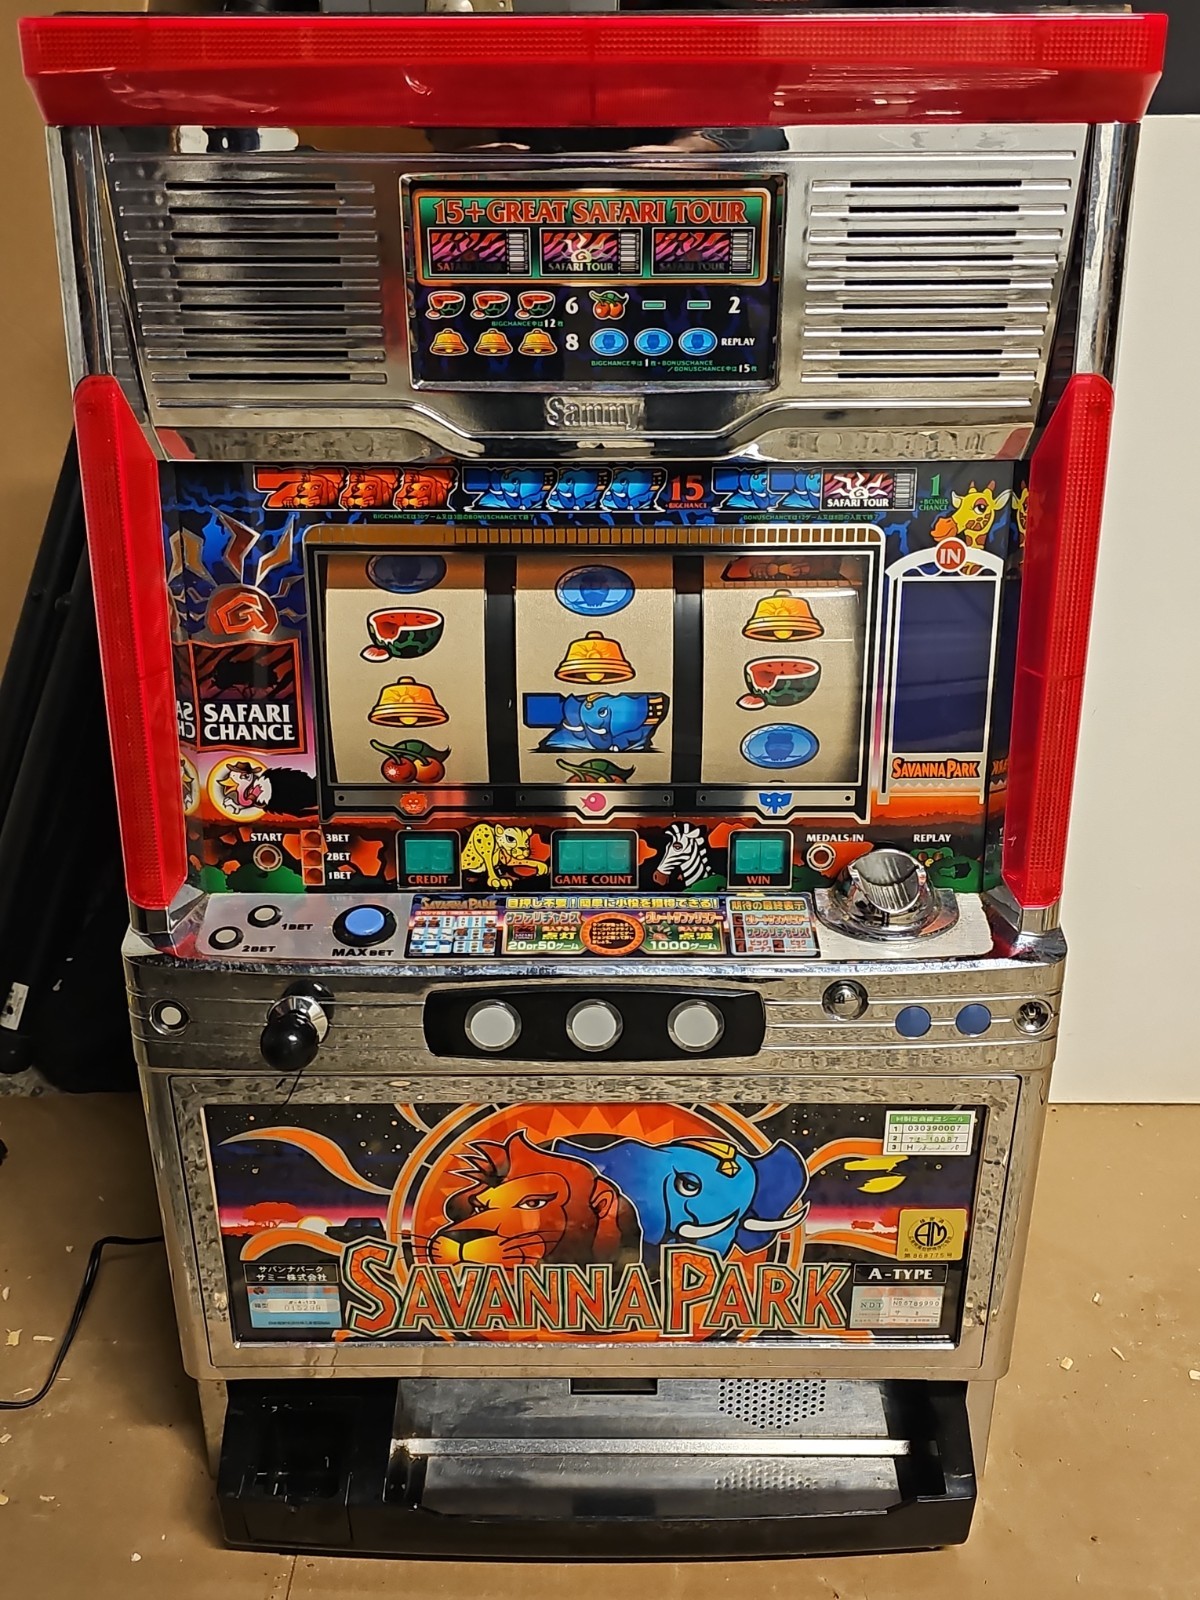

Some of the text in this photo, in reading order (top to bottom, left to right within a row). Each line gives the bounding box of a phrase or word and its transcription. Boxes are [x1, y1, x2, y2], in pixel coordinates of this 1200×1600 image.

[573, 200, 666, 224] SAFARI
[672, 200, 749, 224] TOUR
[548, 262, 614, 272] SAFARI TOUR
[565, 296, 579, 315] 6
[728, 296, 741, 314] 2
[565, 333, 579, 351] 8
[721, 337, 756, 346] REPLAY
[545, 396, 641, 431] Sammy
[670, 473, 705, 500] 15
[929, 474, 941, 497] 1
[827, 499, 890, 508] SAFARI TOUR
[939, 548, 962, 565] IN
[203, 703, 290, 723] SAFARI
[204, 724, 296, 741] CHANCE
[250, 833, 283, 842] START
[326, 833, 350, 843] 3BET
[806, 833, 864, 843] MEDALS IN
[913, 833, 952, 843] REPLAY
[326, 852, 351, 862] 2BET
[328, 872, 352, 880] 1BET
[408, 875, 448, 884] CREDIT
[554, 875, 634, 885] GAME COUNT
[746, 875, 771, 885] WIN
[468, 897, 498, 909] PARK
[282, 923, 313, 931] 1BET
[541, 932, 577, 940] 点灯
[242, 945, 276, 953] 2BET
[650, 941, 717, 950] 1000ゲーム
[332, 948, 368, 957] MAX
[369, 949, 395, 957] BET
[258, 1265, 324, 1273] サバンナパーク
[868, 1267, 934, 1280] A-TYPE
[256, 1273, 328, 1282] サミー株式会社
[344, 1236, 853, 1337] SAVANNA PARK
